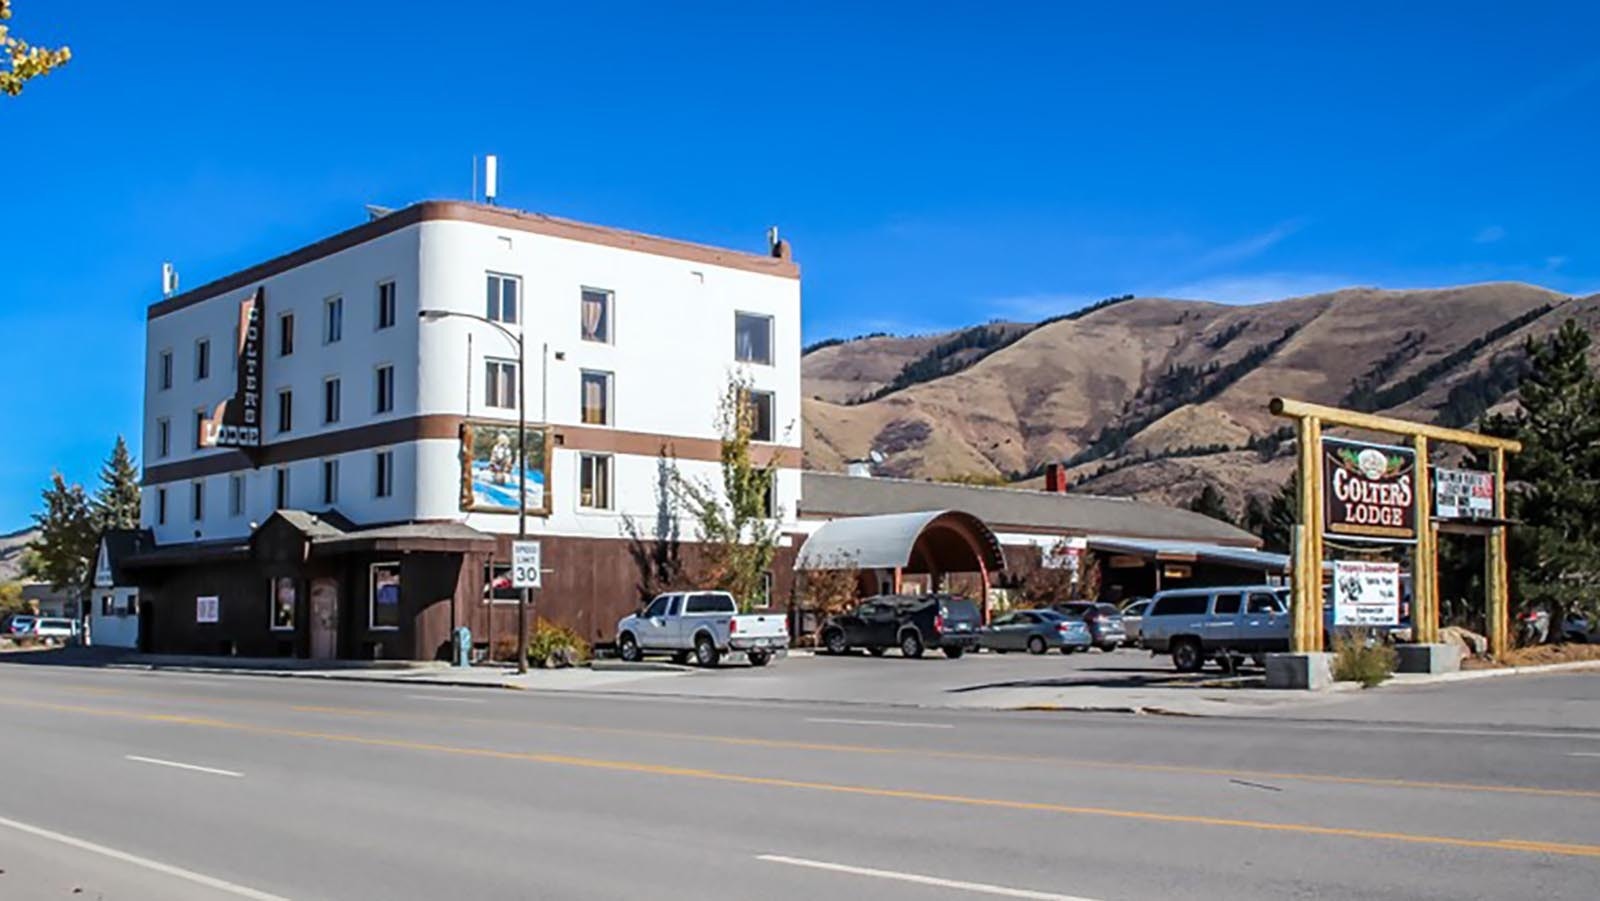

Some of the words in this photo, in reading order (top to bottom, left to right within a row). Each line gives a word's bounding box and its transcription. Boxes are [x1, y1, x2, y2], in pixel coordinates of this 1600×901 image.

[206, 424, 259, 446] LODGE
[1333, 467, 1412, 507] COLTERS
[1345, 502, 1403, 526] LODGE
[516, 566, 537, 582] 30
